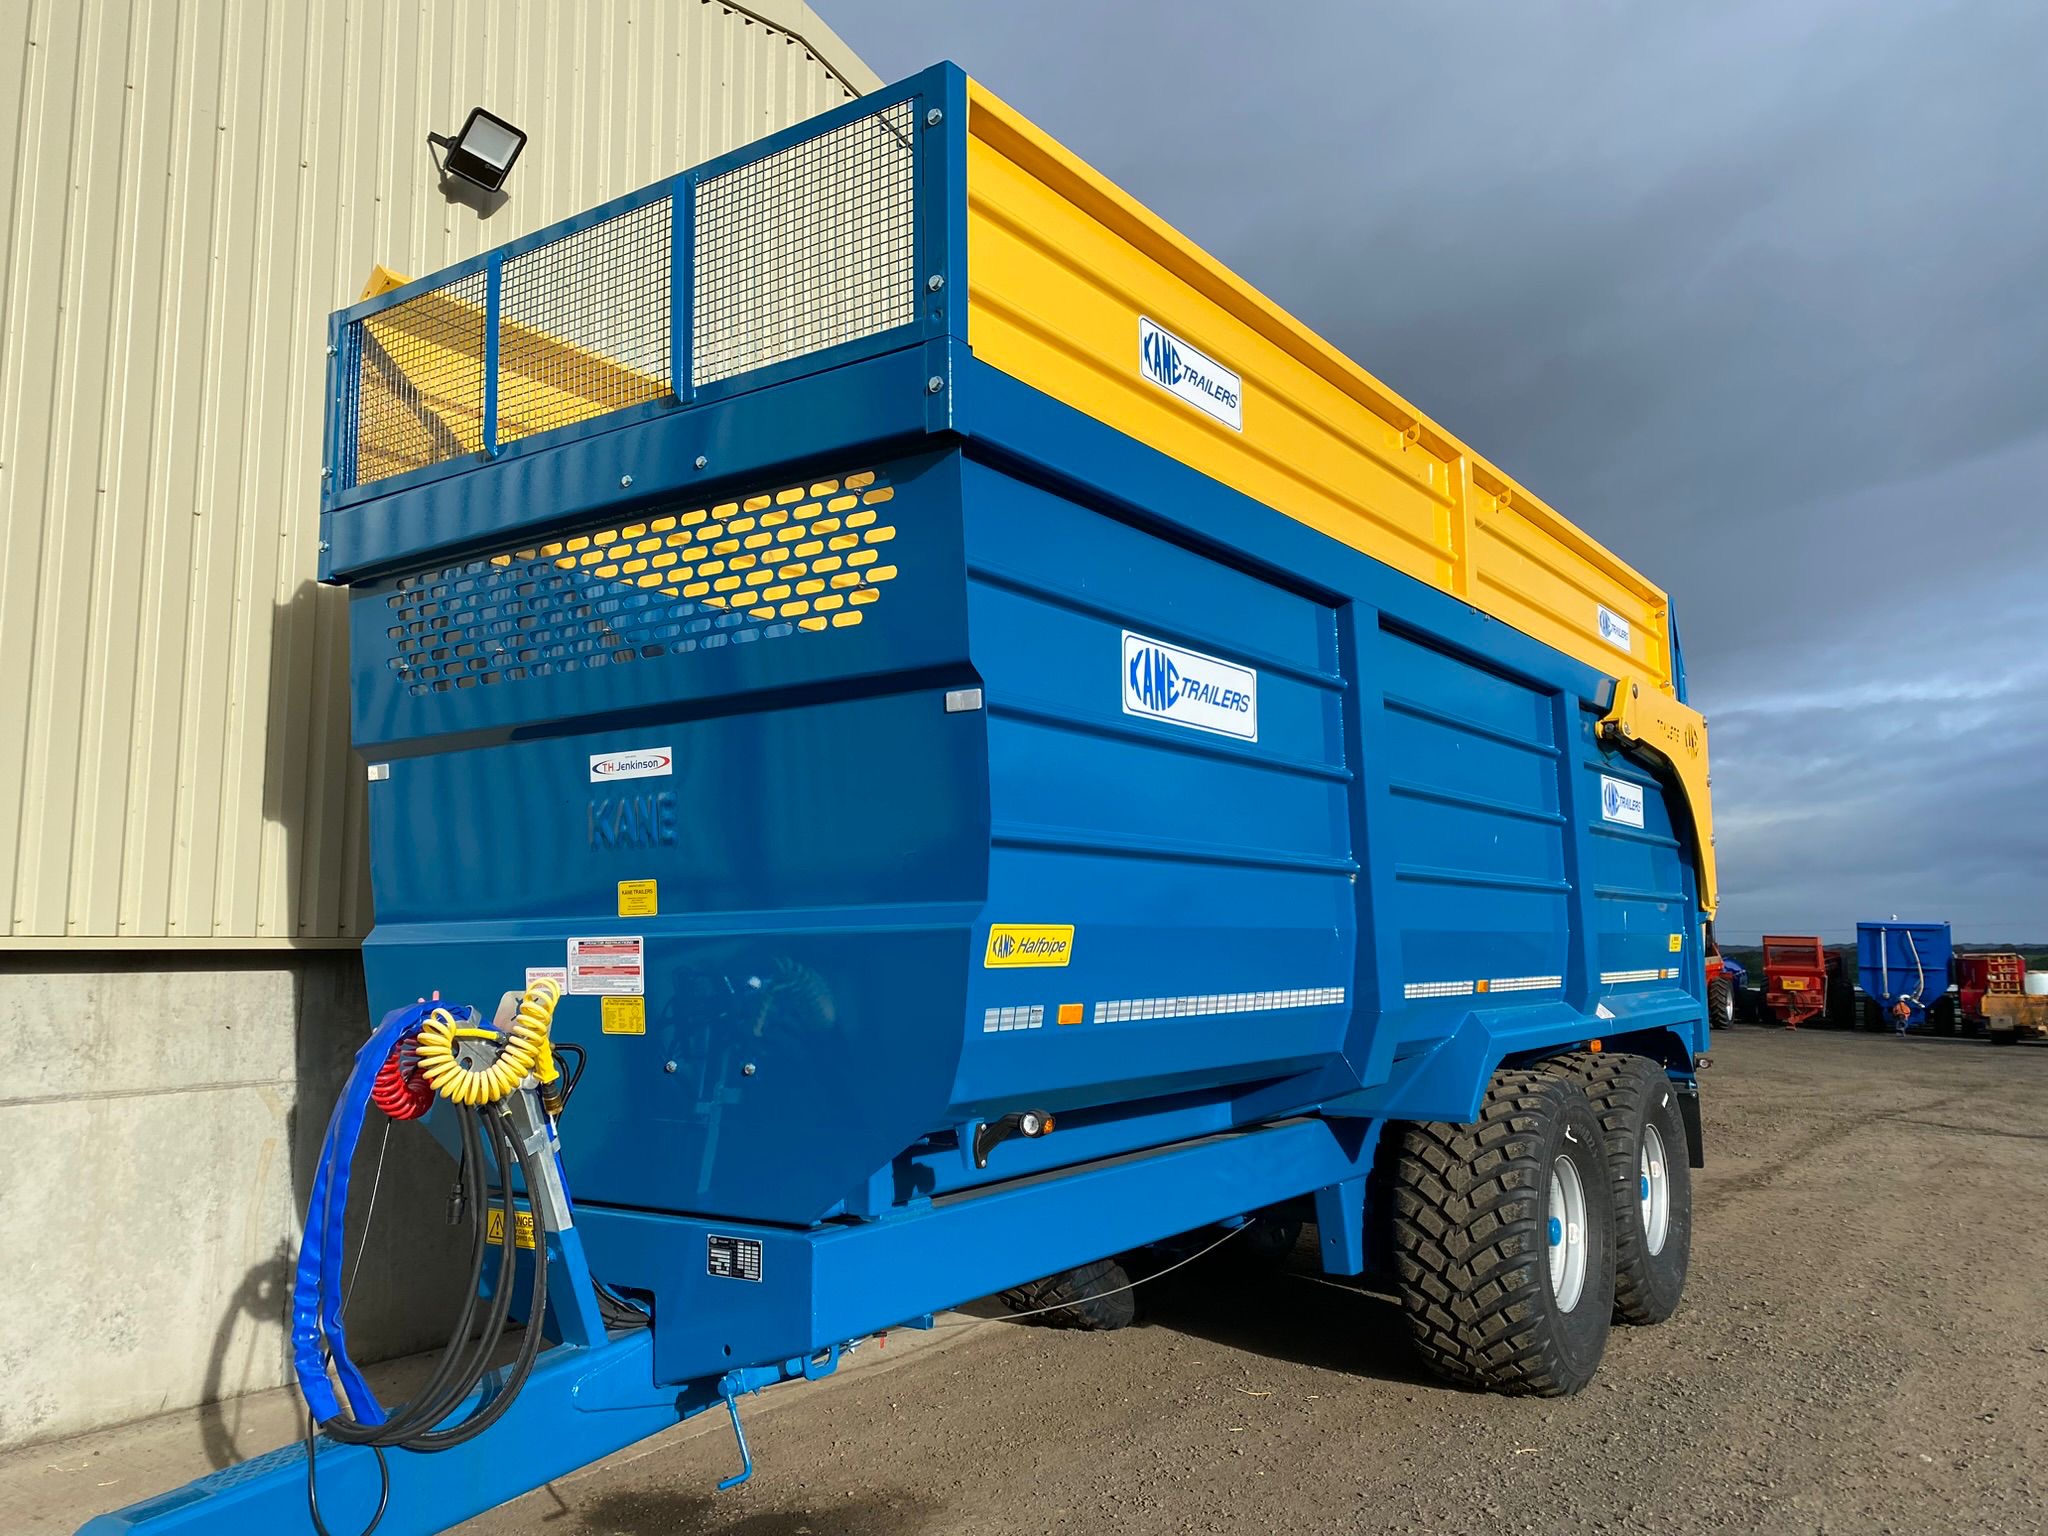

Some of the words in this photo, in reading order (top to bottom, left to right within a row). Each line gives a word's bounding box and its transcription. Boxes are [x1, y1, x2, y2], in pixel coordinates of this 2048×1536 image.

[1144, 332, 1182, 385] KANE
[1182, 365, 1238, 408] TRAILERS
[1130, 648, 1180, 711] KANE
[1181, 677, 1250, 713] TRAILERS
[602, 762, 614, 773] TH
[616, 759, 659, 772] Jenkinson
[588, 792, 677, 851] KANE
[992, 933, 1016, 959] KANE
[1016, 936, 1067, 957] Halfpipe
